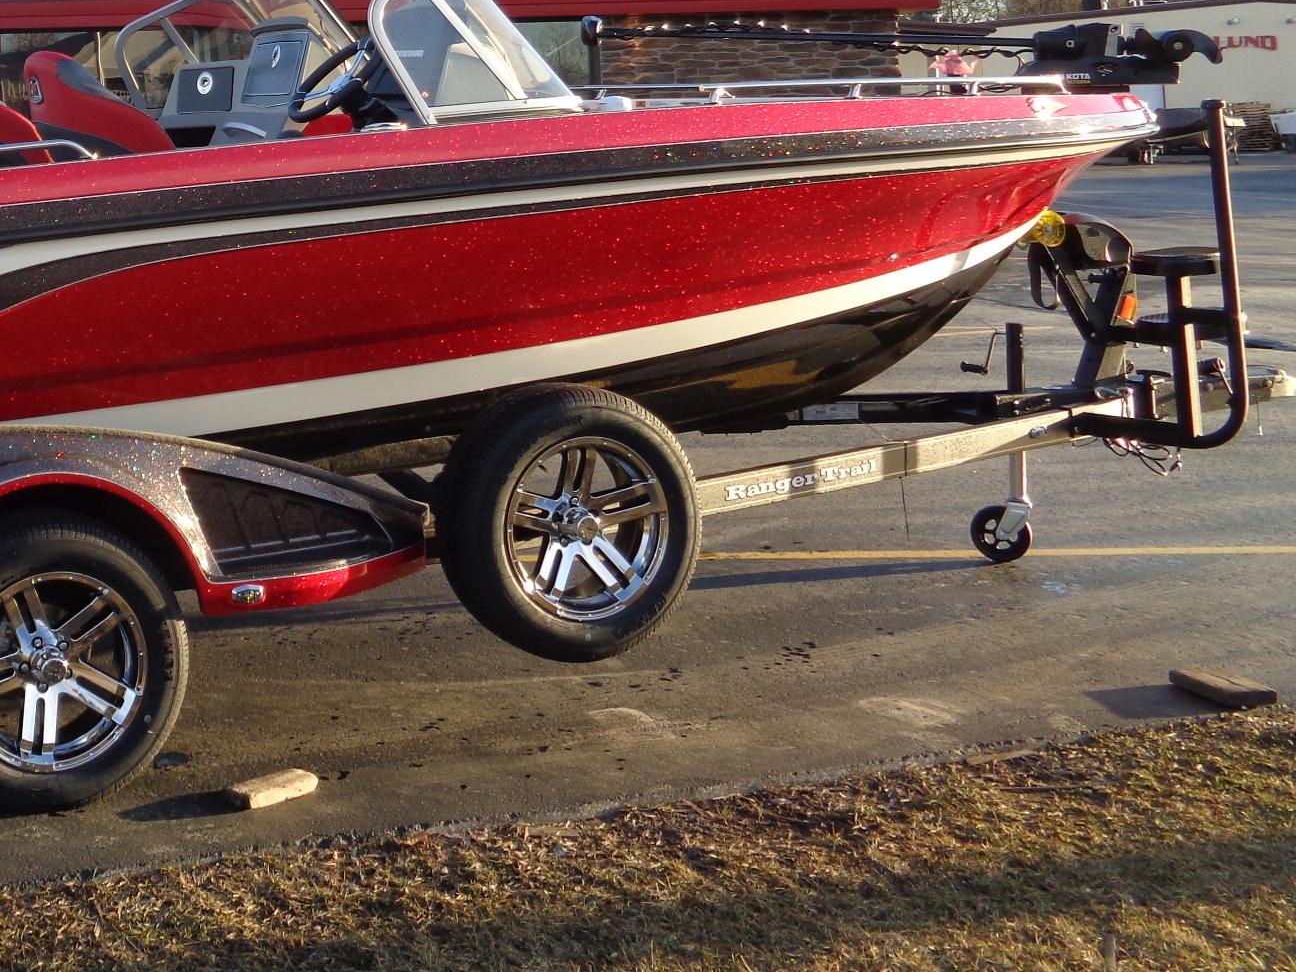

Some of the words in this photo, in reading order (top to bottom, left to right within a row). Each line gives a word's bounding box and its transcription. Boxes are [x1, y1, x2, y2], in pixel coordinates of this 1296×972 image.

[1212, 35, 1278, 51] LUND
[725, 472, 818, 501] Ranger
[821, 459, 881, 482] Trail
